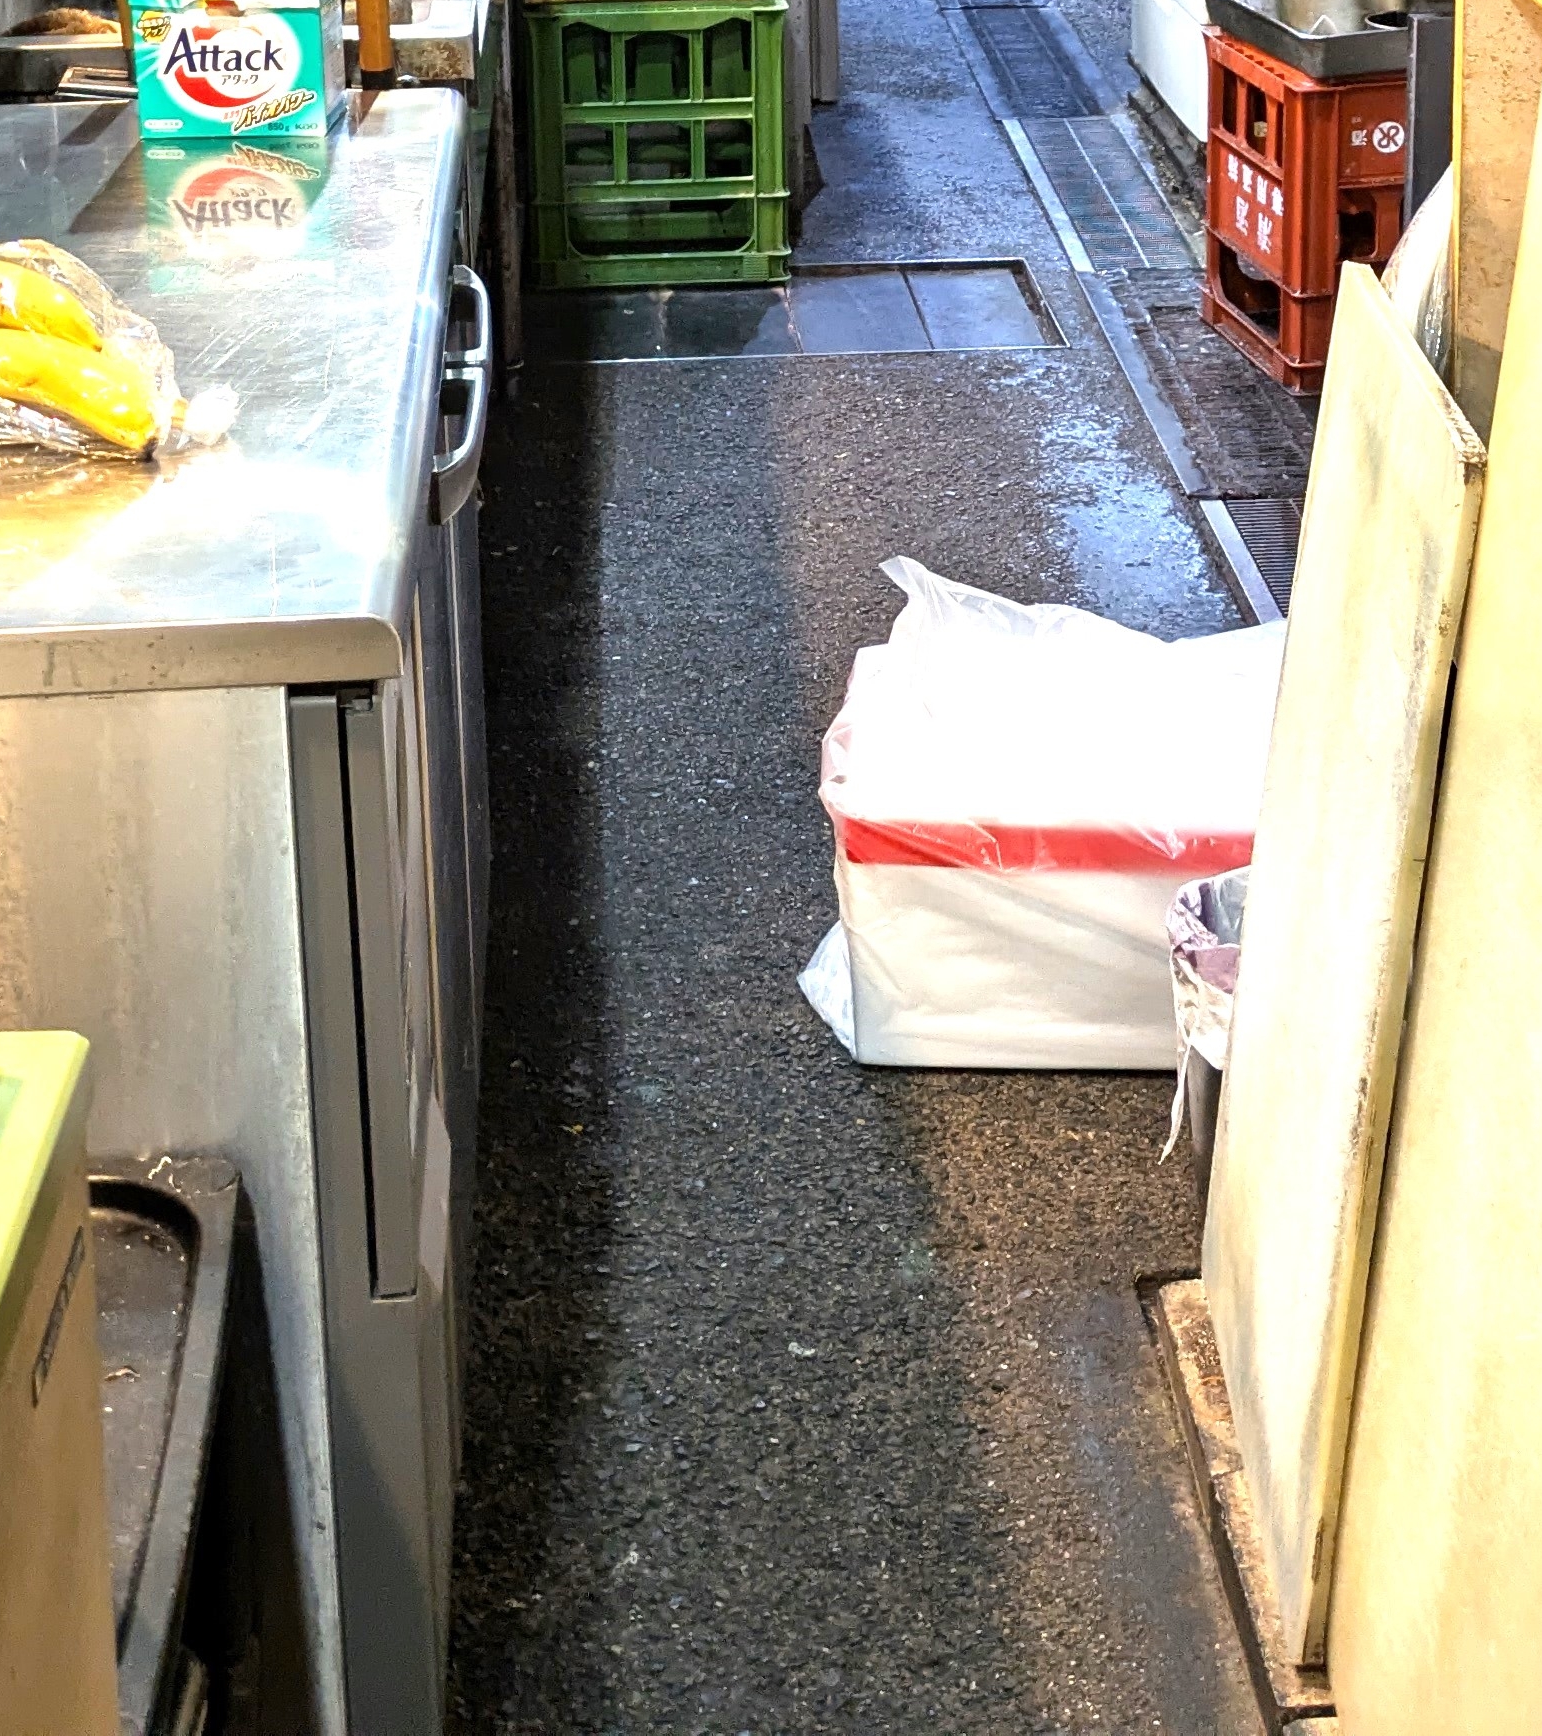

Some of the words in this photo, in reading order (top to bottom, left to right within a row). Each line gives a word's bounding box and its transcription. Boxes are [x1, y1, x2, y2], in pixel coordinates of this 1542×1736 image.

[163, 27, 284, 75] Attack
[221, 74, 260, 86] アタック
